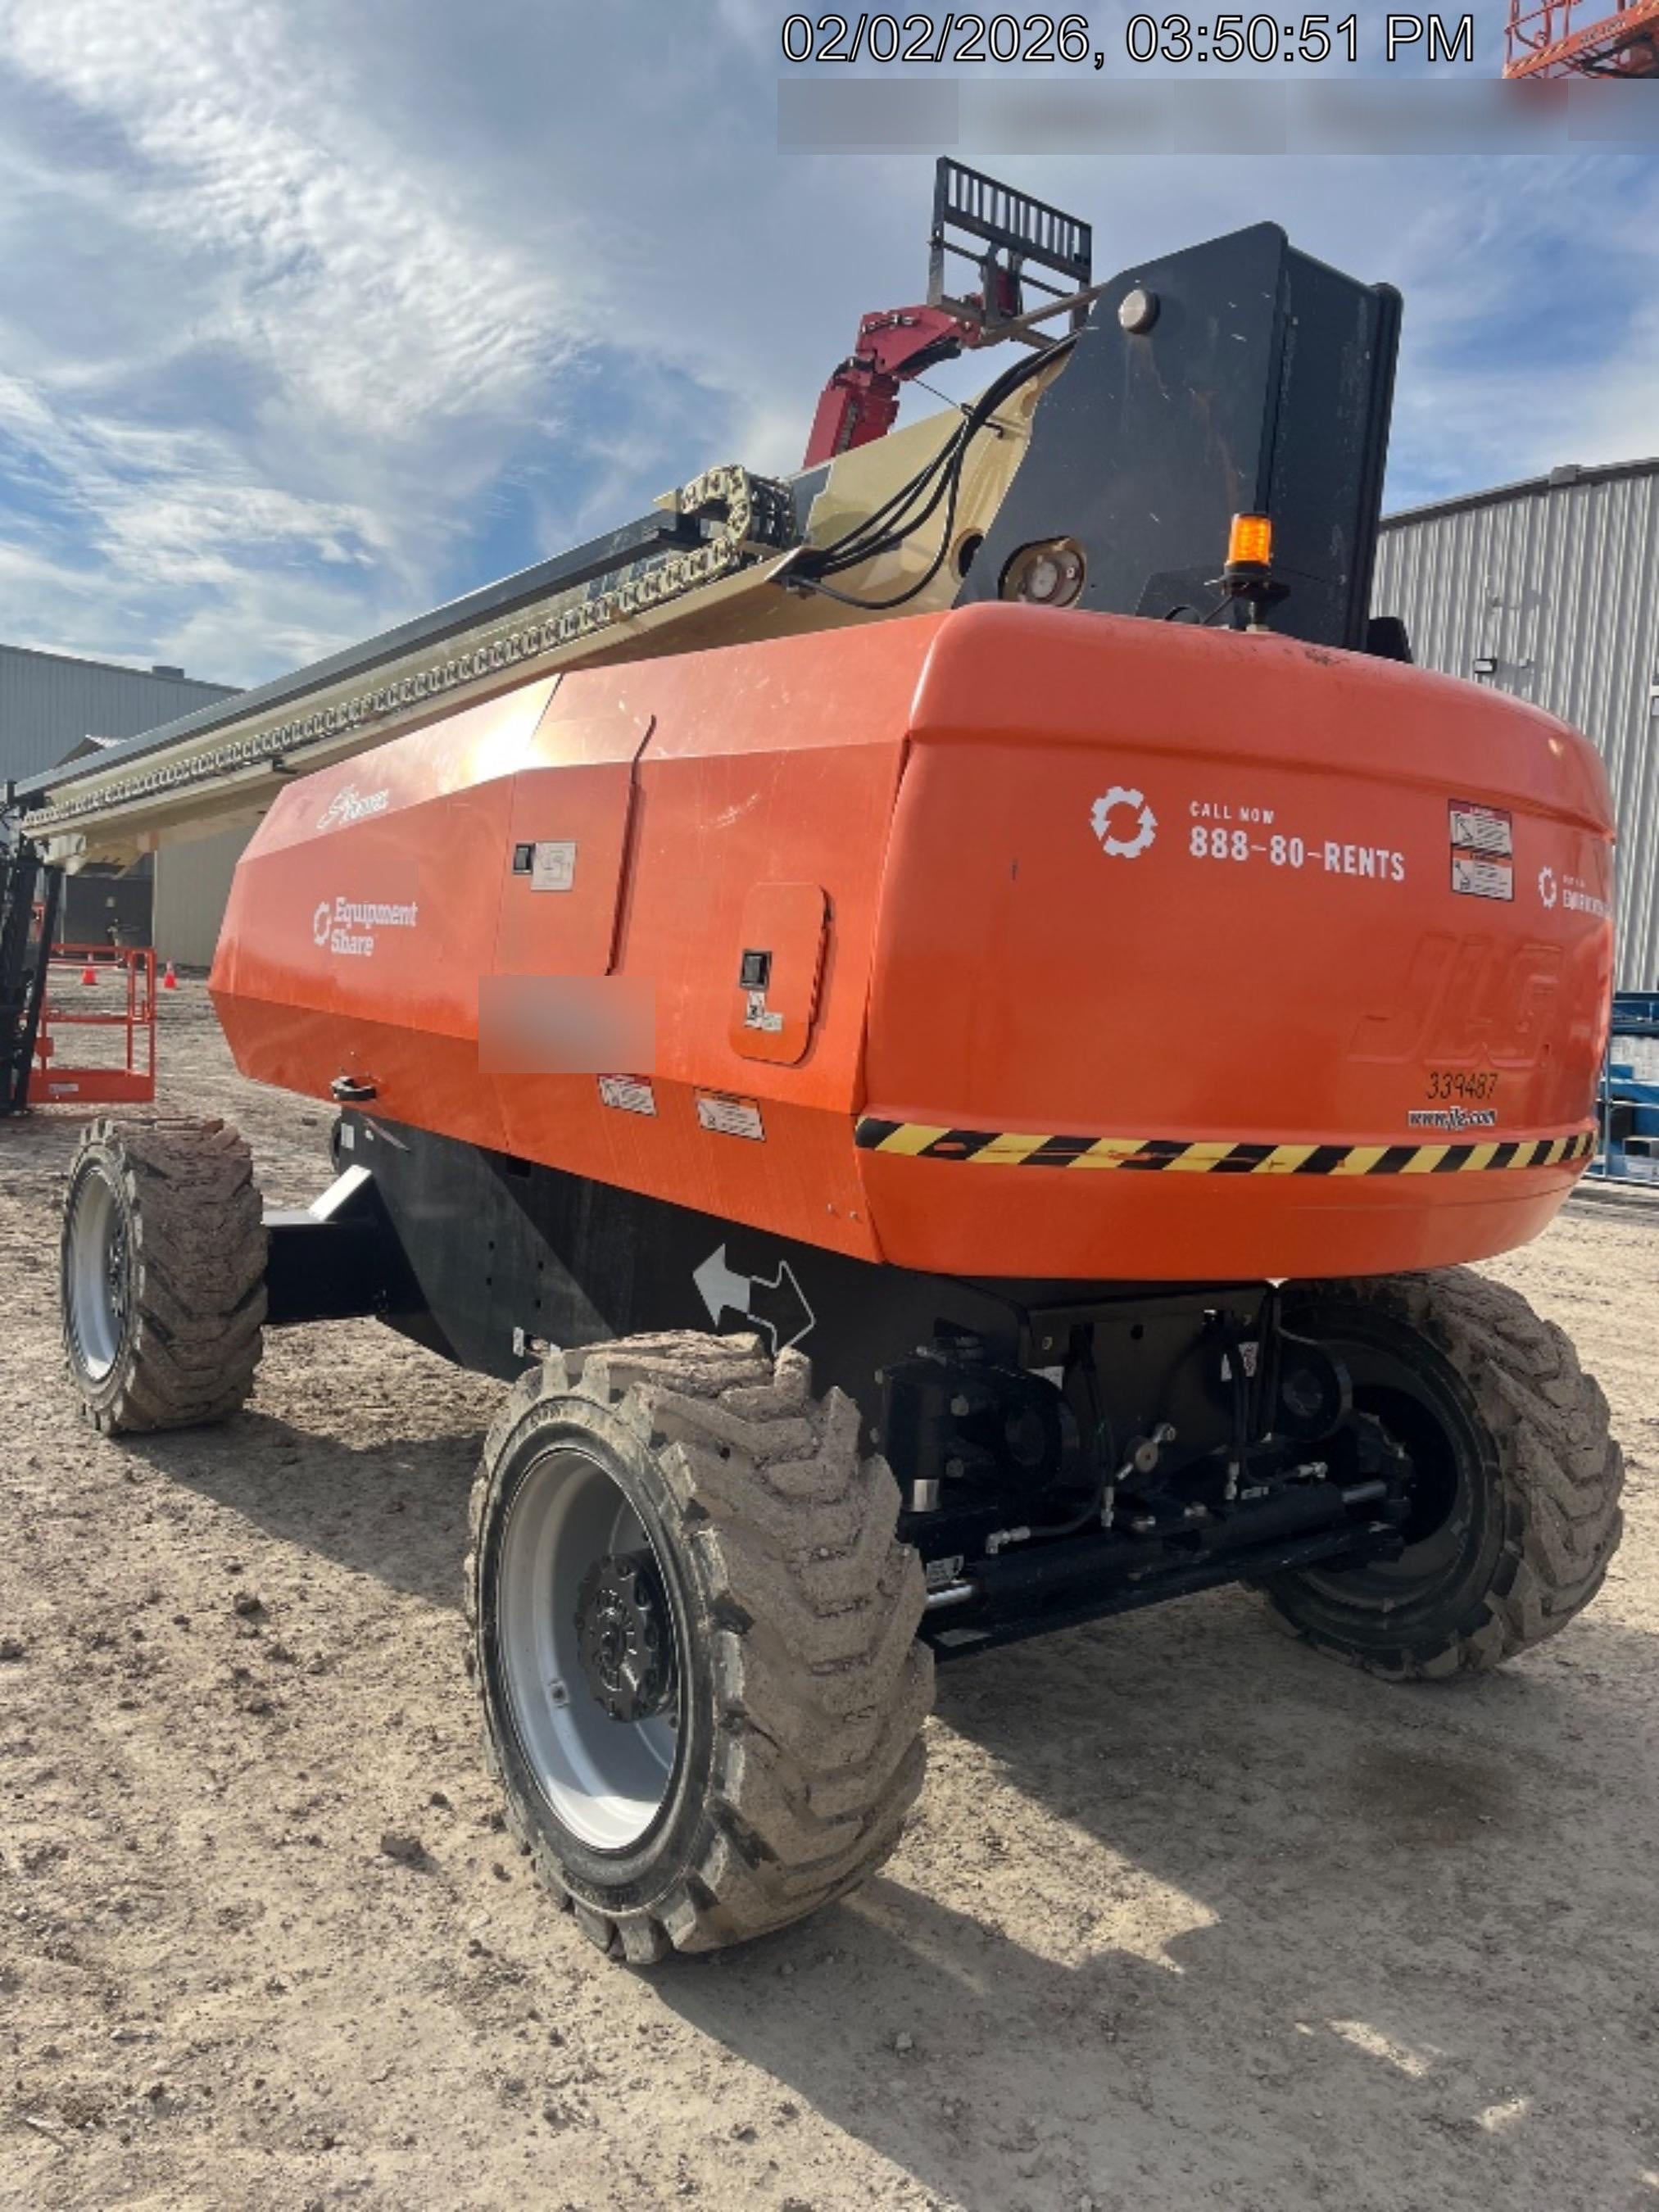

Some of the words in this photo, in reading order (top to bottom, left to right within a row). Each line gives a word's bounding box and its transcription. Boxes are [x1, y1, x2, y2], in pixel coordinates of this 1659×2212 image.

[1190, 801, 1231, 819] CALL
[1240, 806, 1274, 824] NOW
[1190, 826, 1404, 882] 888-80-RENTS
[333, 896, 418, 929] Equipment
[331, 928, 374, 957] Share
